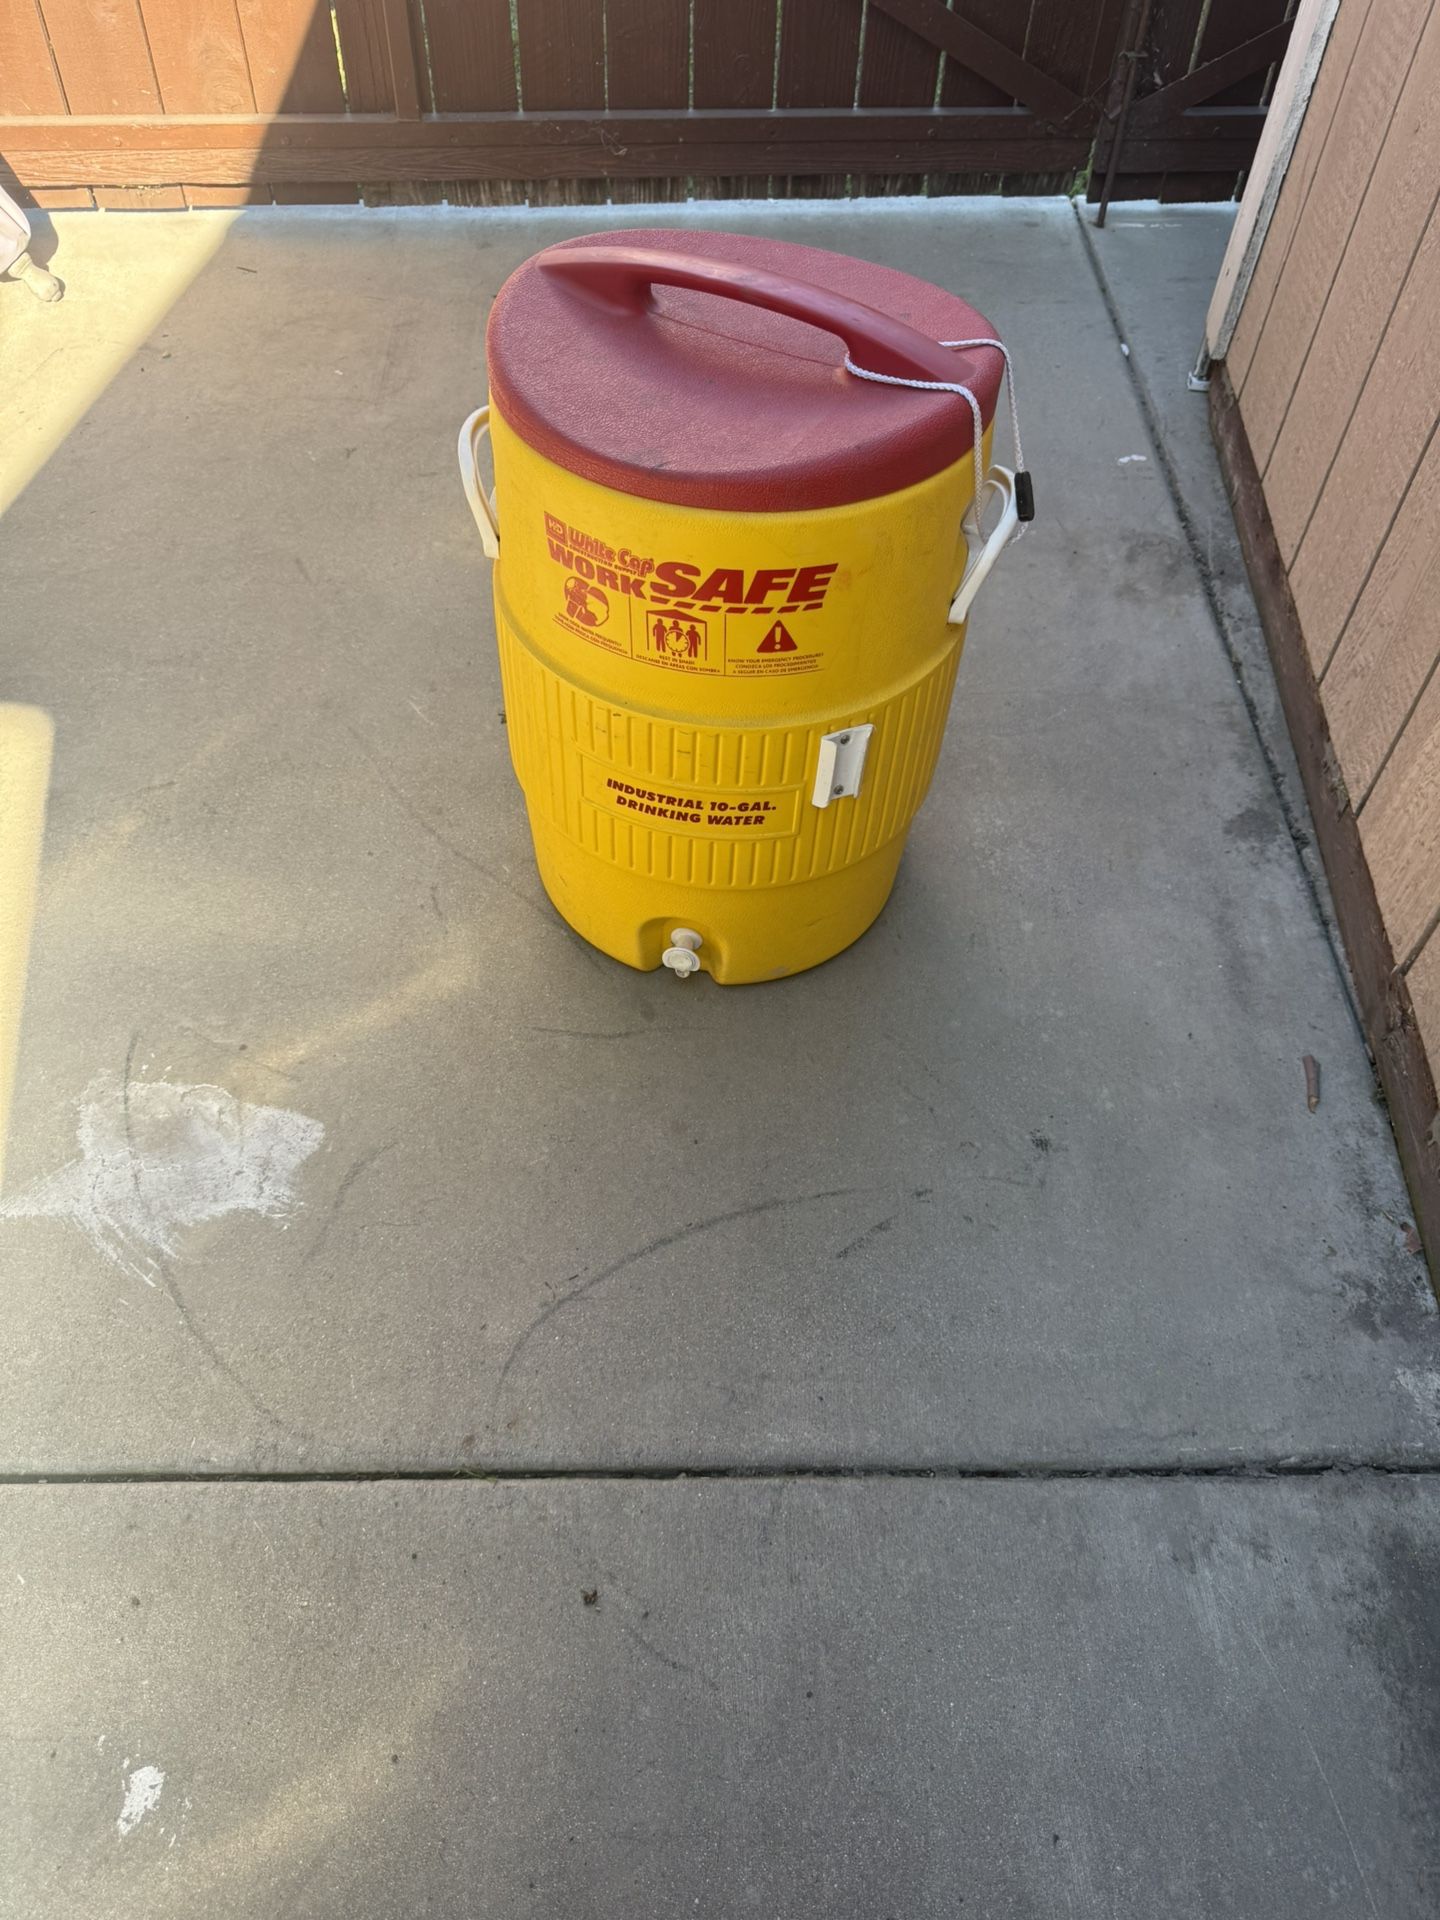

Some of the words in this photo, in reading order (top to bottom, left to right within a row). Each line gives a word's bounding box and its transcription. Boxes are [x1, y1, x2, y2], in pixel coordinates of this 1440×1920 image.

[547, 537, 647, 601] WORK
[650, 561, 838, 605] SAFE
[568, 526, 616, 562] White
[618, 548, 655, 578] Cap
[606, 778, 704, 810] INDUSTRIAL
[709, 800, 777, 812] 10-GAL.
[616, 795, 701, 823] DRINKING
[707, 815, 766, 826] WATER
